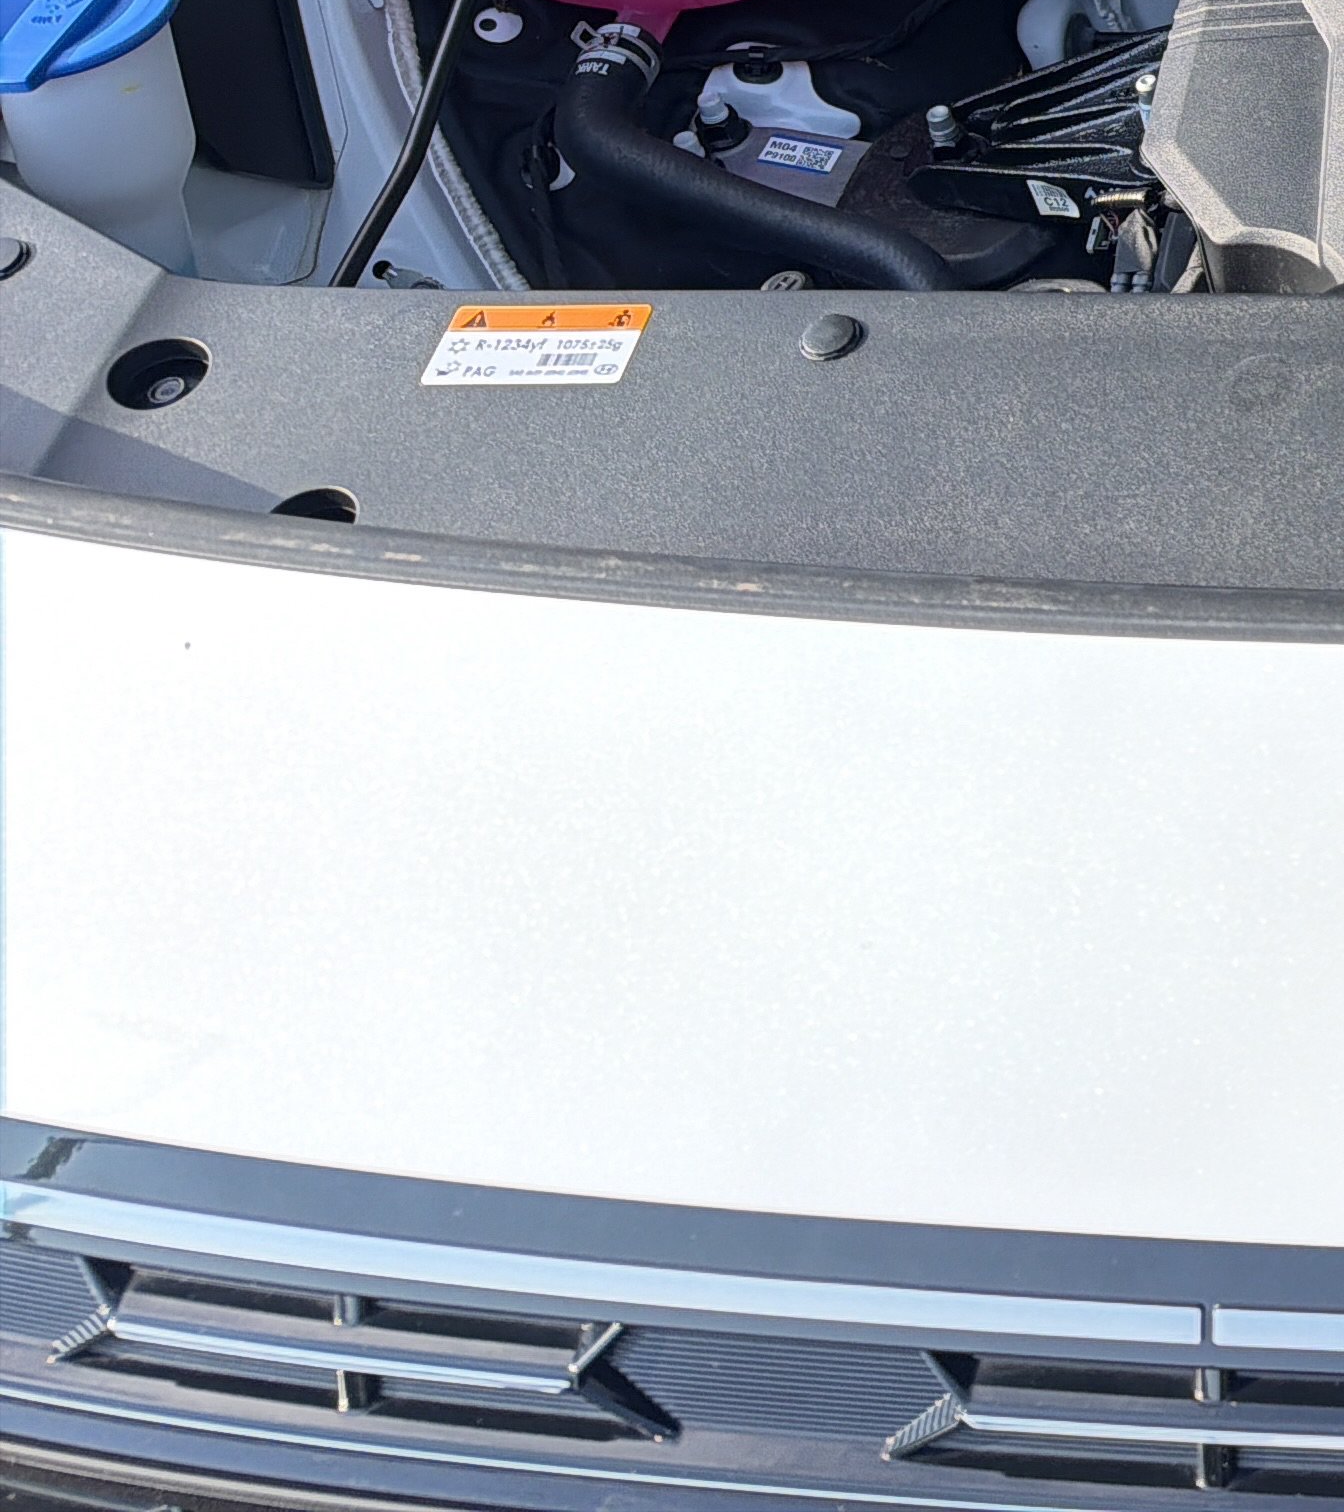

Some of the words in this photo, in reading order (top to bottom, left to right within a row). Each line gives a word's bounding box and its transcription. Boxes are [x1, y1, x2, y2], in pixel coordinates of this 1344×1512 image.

[769, 140, 798, 152] M04
[764, 150, 797, 163] P9100
[1043, 197, 1069, 207] C12
[474, 338, 548, 354] R-1234yf
[462, 365, 497, 378] PAG
